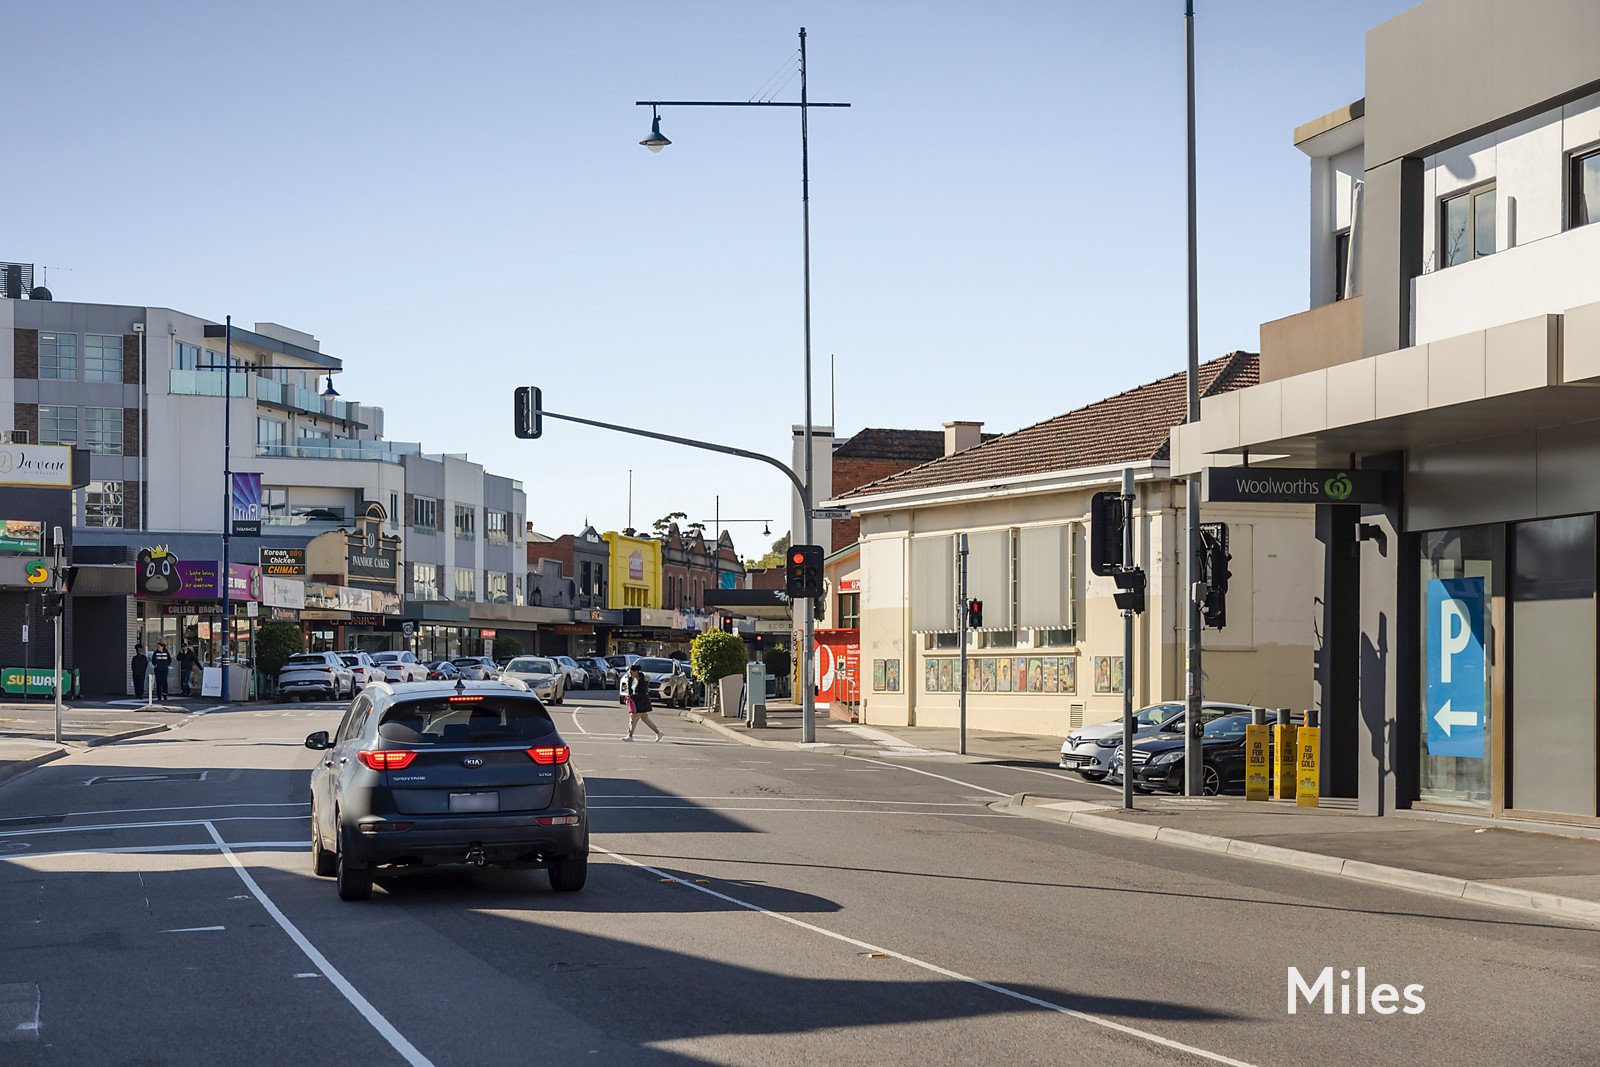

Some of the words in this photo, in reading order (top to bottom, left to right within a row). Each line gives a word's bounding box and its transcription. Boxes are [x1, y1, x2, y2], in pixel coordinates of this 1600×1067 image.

[1236, 477, 1319, 494] Woolworths
[352, 555, 373, 567] IVANHOE
[374, 558, 390, 569] CAKES
[268, 566, 299, 574] CHIMAC
[168, 605, 196, 614] COLLEGE
[1253, 741, 1262, 749] GO
[1304, 745, 1312, 753] GO
[1250, 756, 1265, 764] GOLD
[1303, 752, 1314, 760] FOR
[1301, 760, 1315, 768] GOLD
